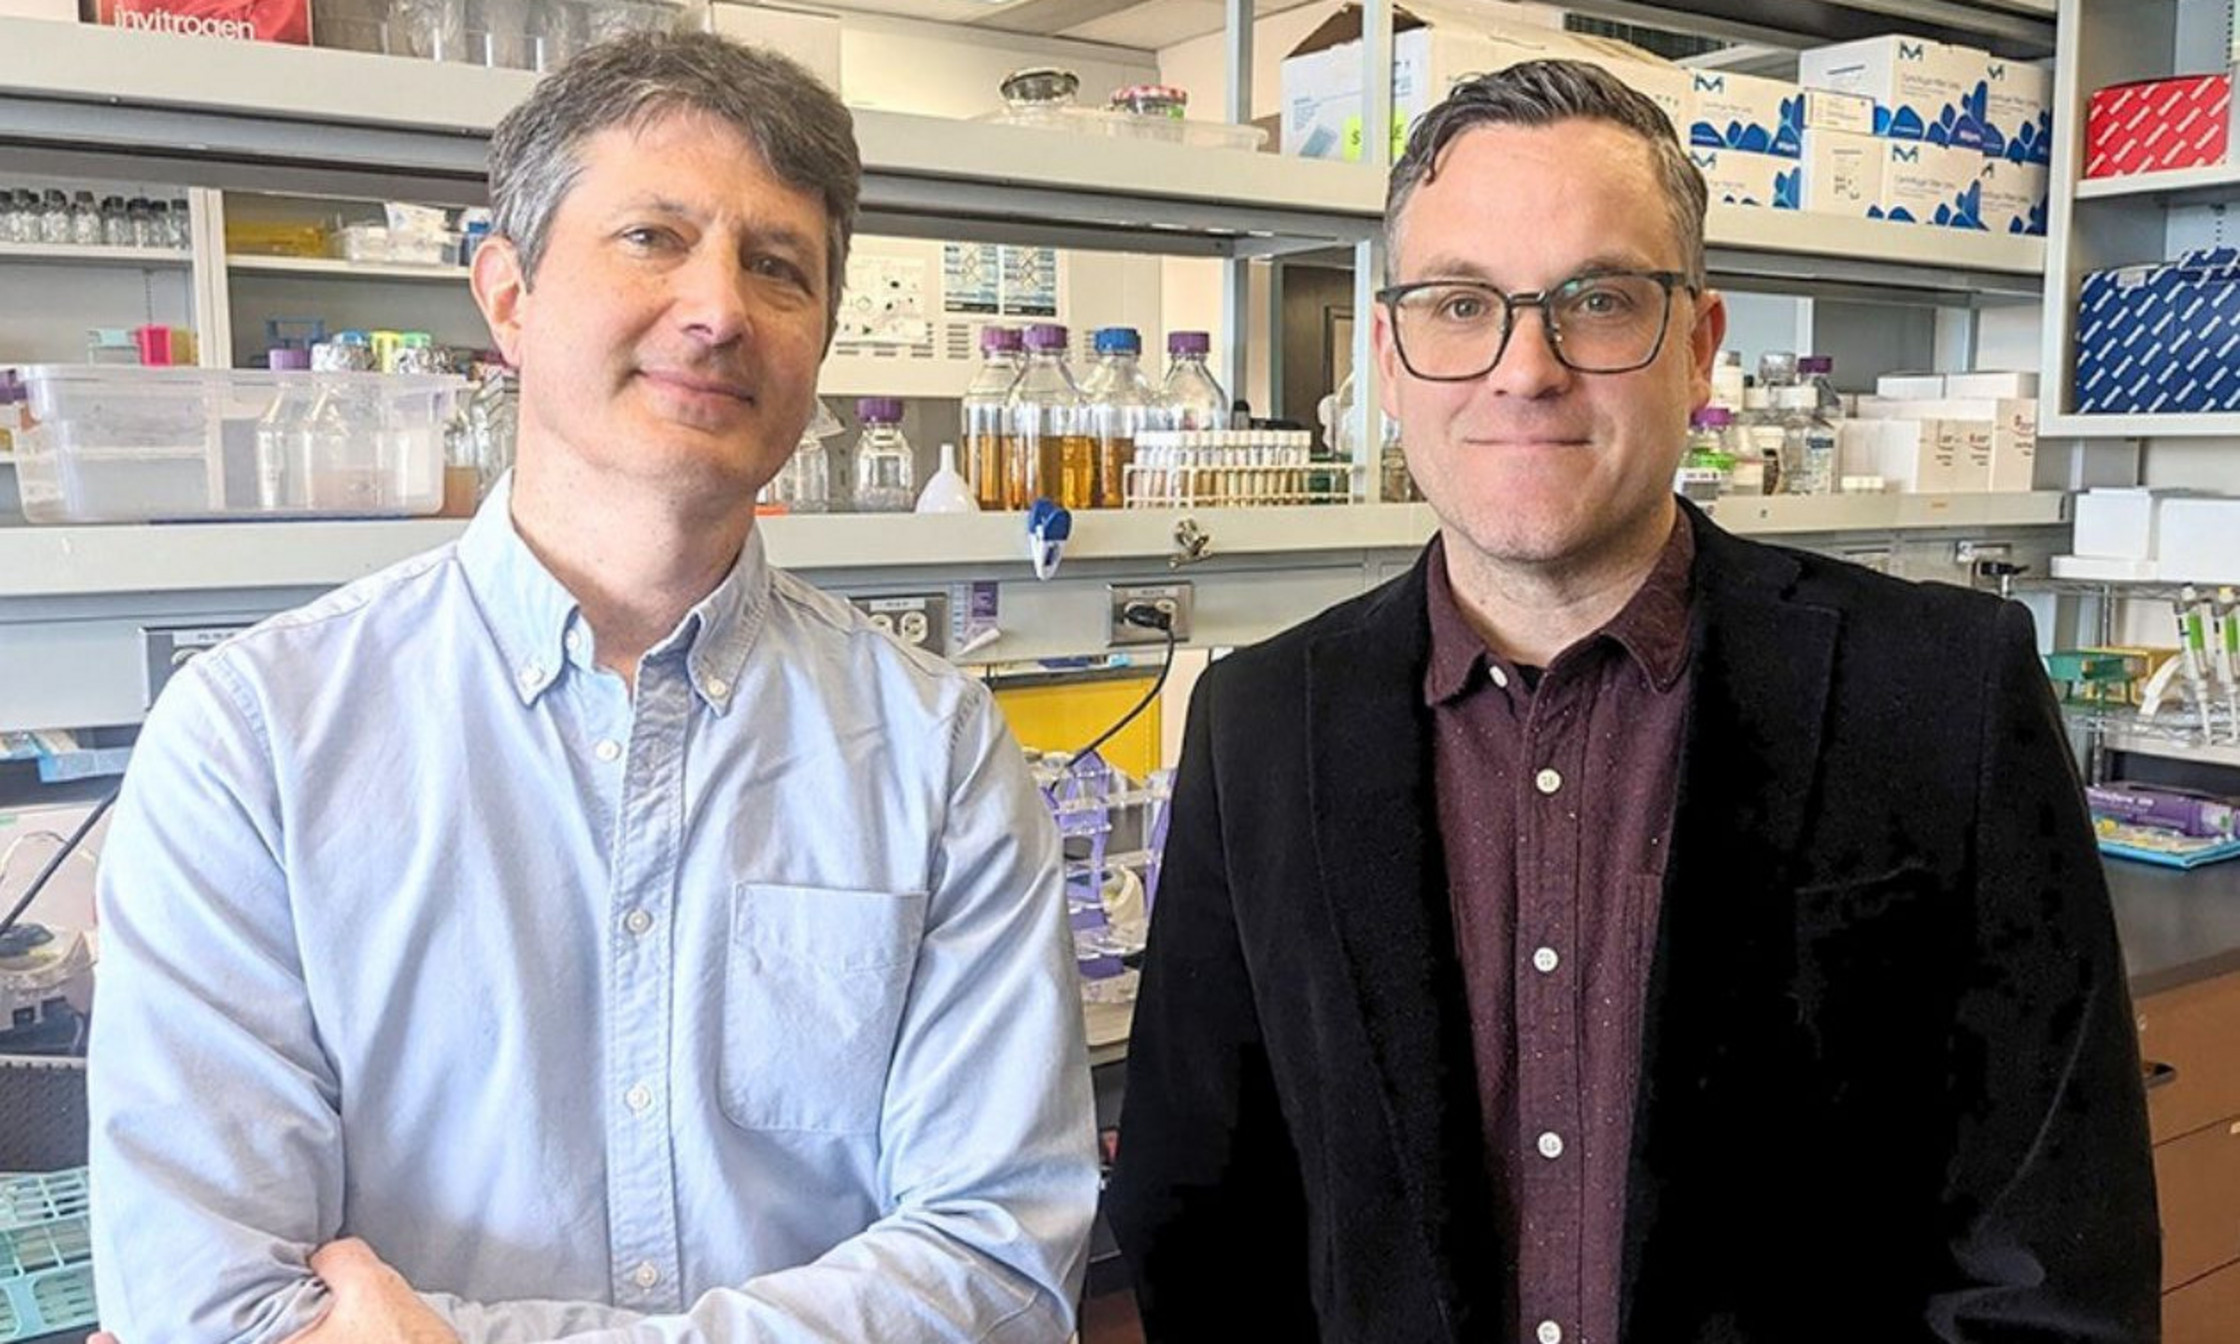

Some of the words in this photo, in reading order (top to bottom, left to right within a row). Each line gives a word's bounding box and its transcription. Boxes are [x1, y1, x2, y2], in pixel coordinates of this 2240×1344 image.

[1899, 41, 1924, 61] M
[1694, 73, 1724, 93] M
[1892, 144, 1919, 163] M
